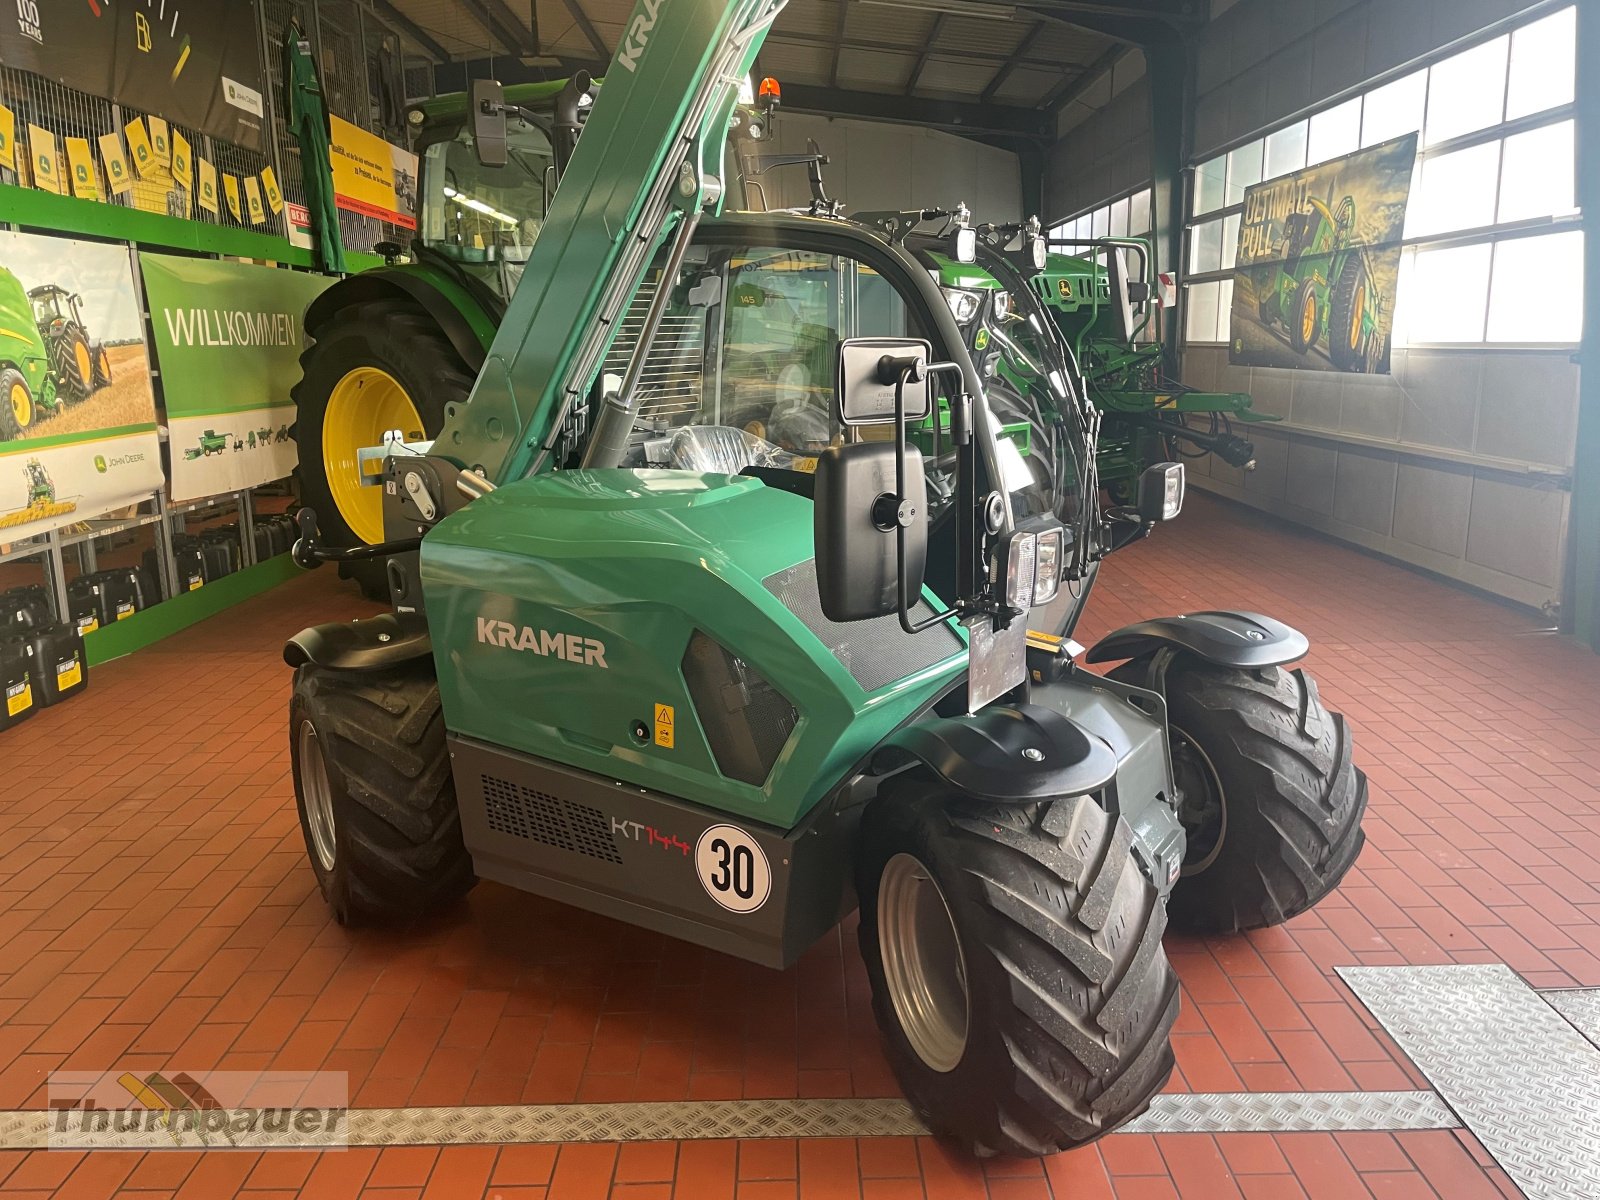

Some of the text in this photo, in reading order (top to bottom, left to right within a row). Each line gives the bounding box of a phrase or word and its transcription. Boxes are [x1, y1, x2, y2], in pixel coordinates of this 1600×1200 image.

[1245, 175, 1316, 226] ULTIMATE
[1240, 223, 1273, 258] PULL
[740, 295, 756, 304] 145
[164, 308, 296, 346] WILLKOMMEN
[108, 453, 145, 467] JOHN DEERE
[477, 617, 609, 669] KRAMER
[611, 816, 691, 857] KT144
[710, 838, 754, 900] 30
